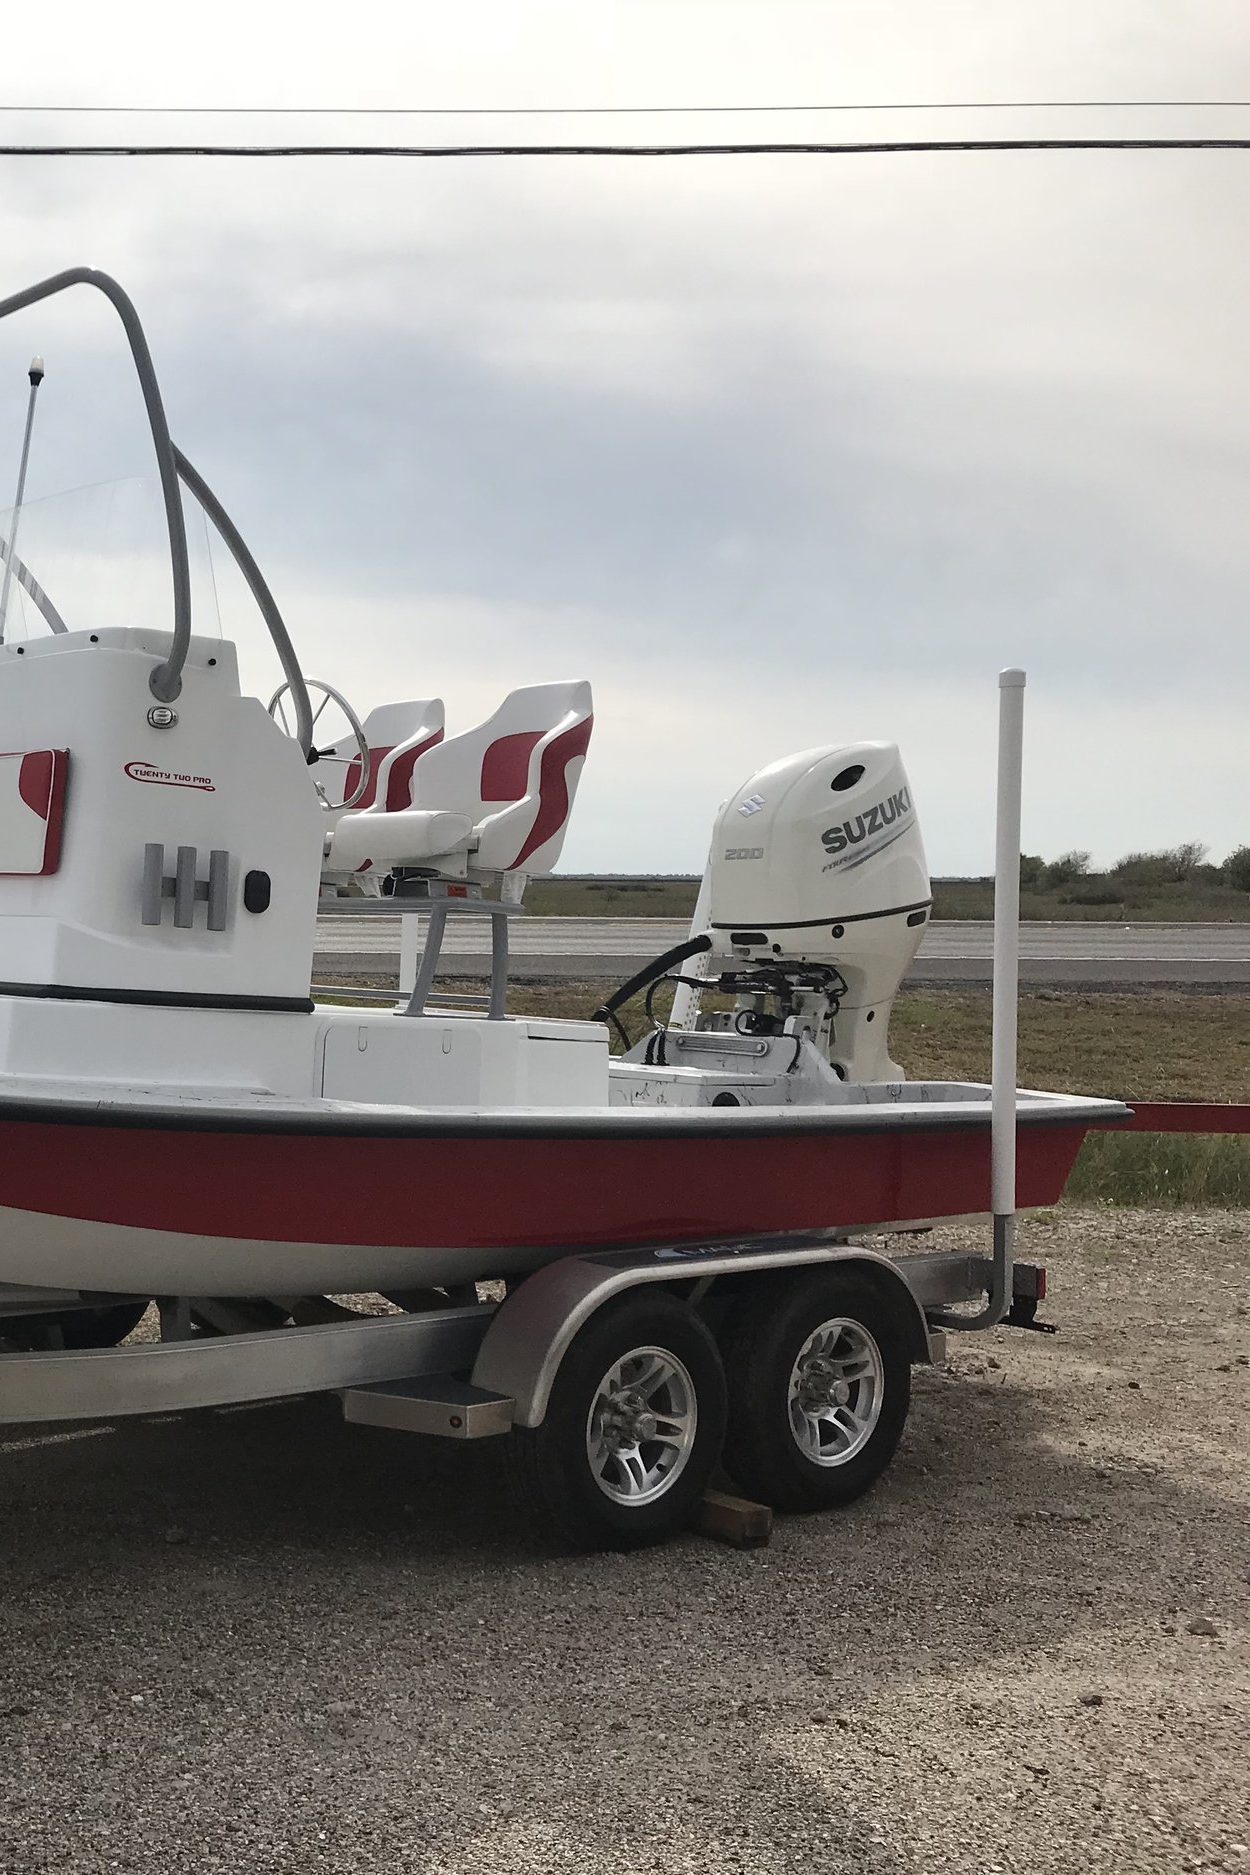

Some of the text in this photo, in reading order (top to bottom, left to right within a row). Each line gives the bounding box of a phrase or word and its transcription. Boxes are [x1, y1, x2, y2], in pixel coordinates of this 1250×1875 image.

[193, 776, 211, 784] PRO
[821, 786, 911, 854] SUZUKI
[725, 848, 764, 860] 200
